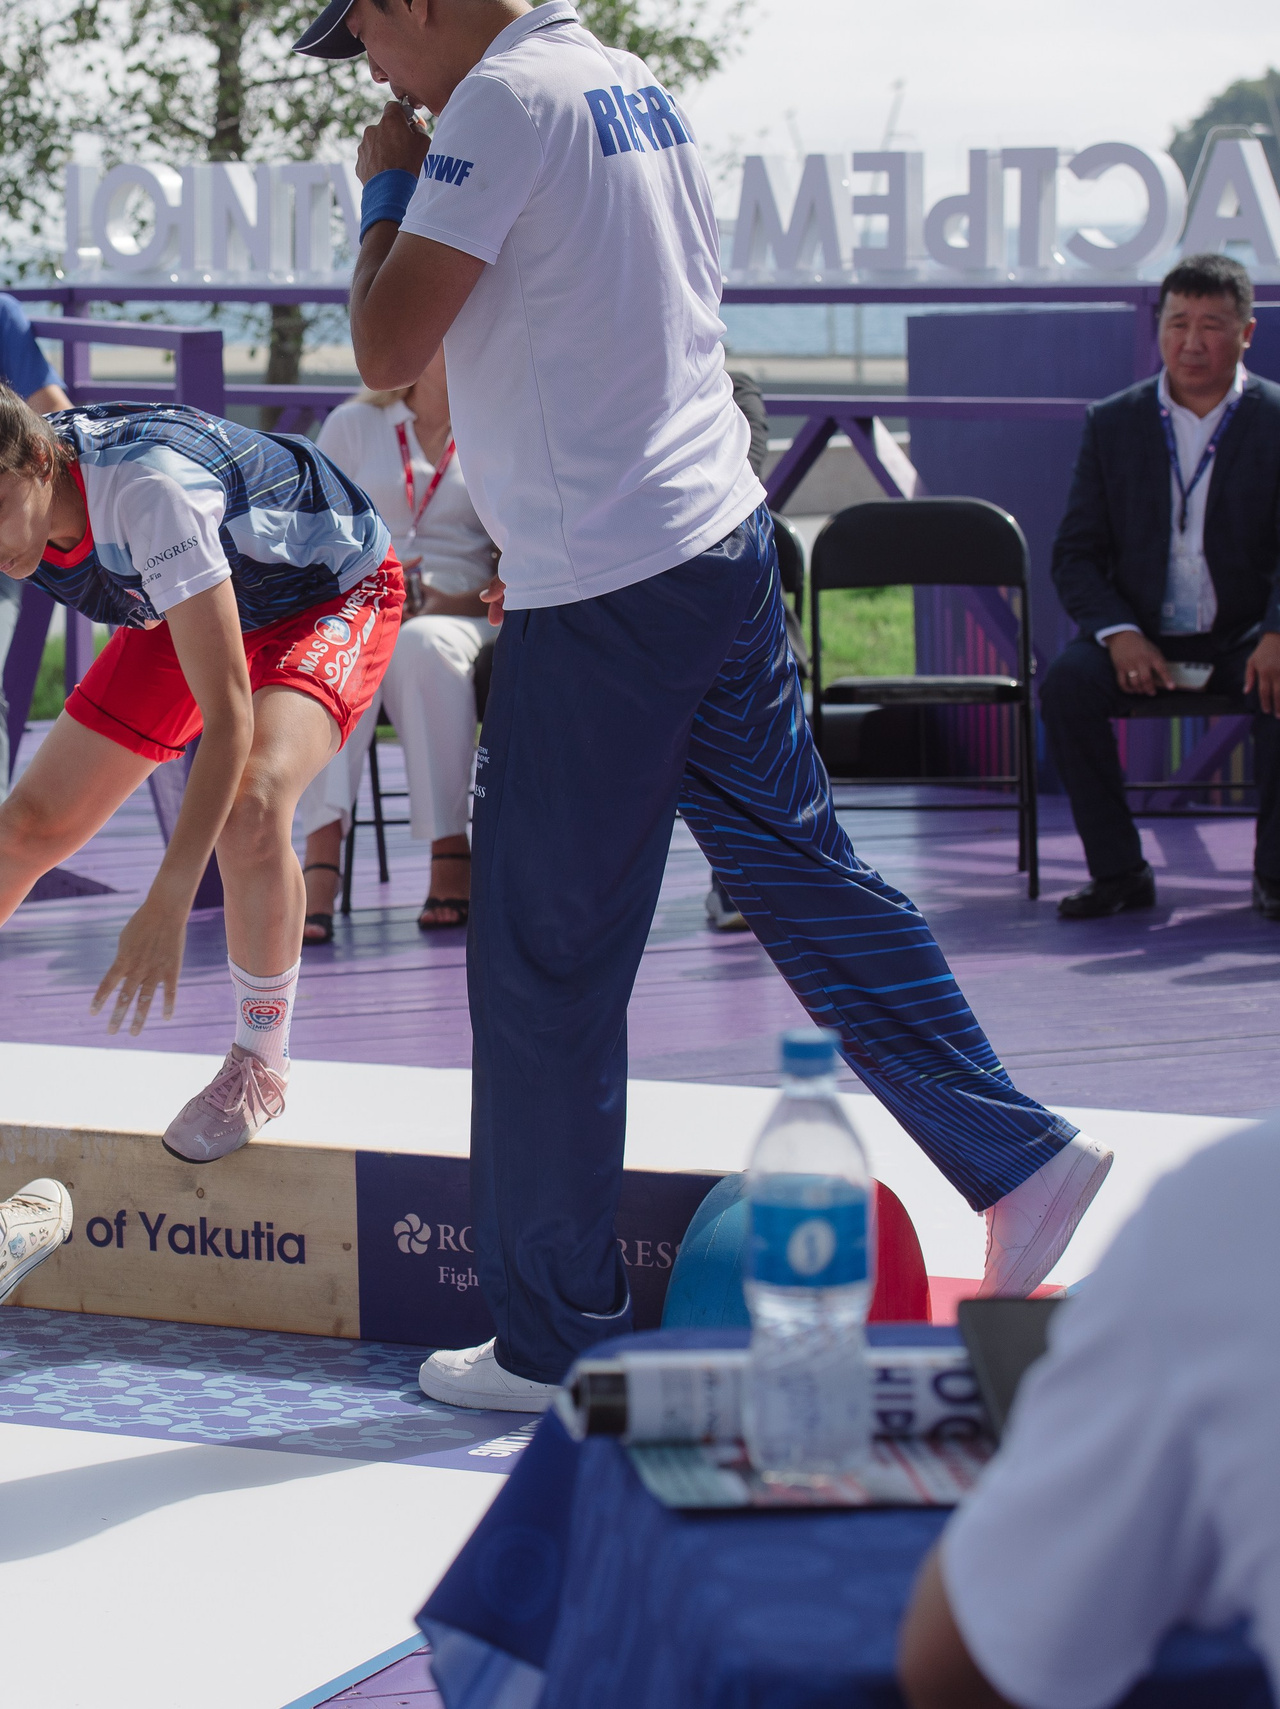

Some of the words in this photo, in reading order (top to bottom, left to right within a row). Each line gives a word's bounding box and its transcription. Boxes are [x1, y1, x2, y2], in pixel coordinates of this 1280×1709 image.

[86, 1209, 127, 1249] of
[138, 1211, 306, 1264] Yakutia
[438, 1266, 480, 1292] Figh
